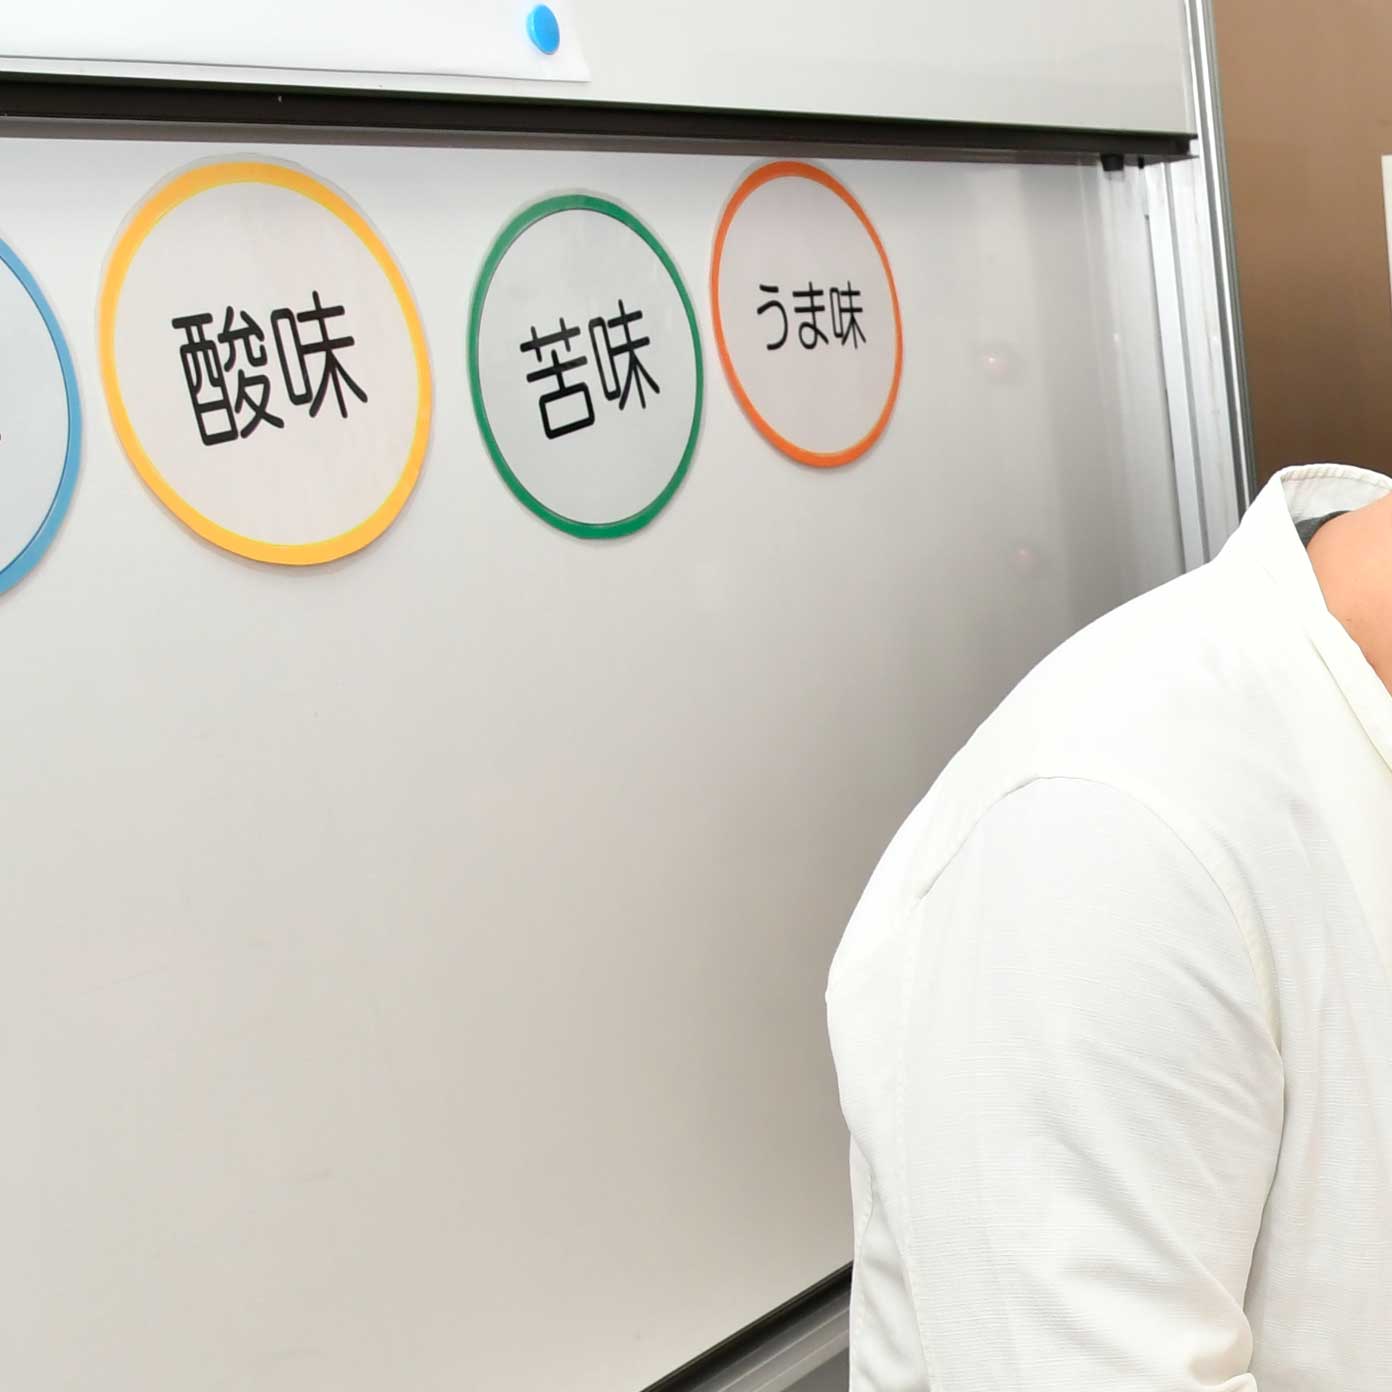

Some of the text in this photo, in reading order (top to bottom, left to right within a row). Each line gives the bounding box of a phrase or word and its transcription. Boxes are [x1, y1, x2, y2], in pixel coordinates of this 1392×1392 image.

[171, 290, 368, 446] 酸味
[519, 299, 661, 440] 苦味
[756, 281, 867, 350] うま味
